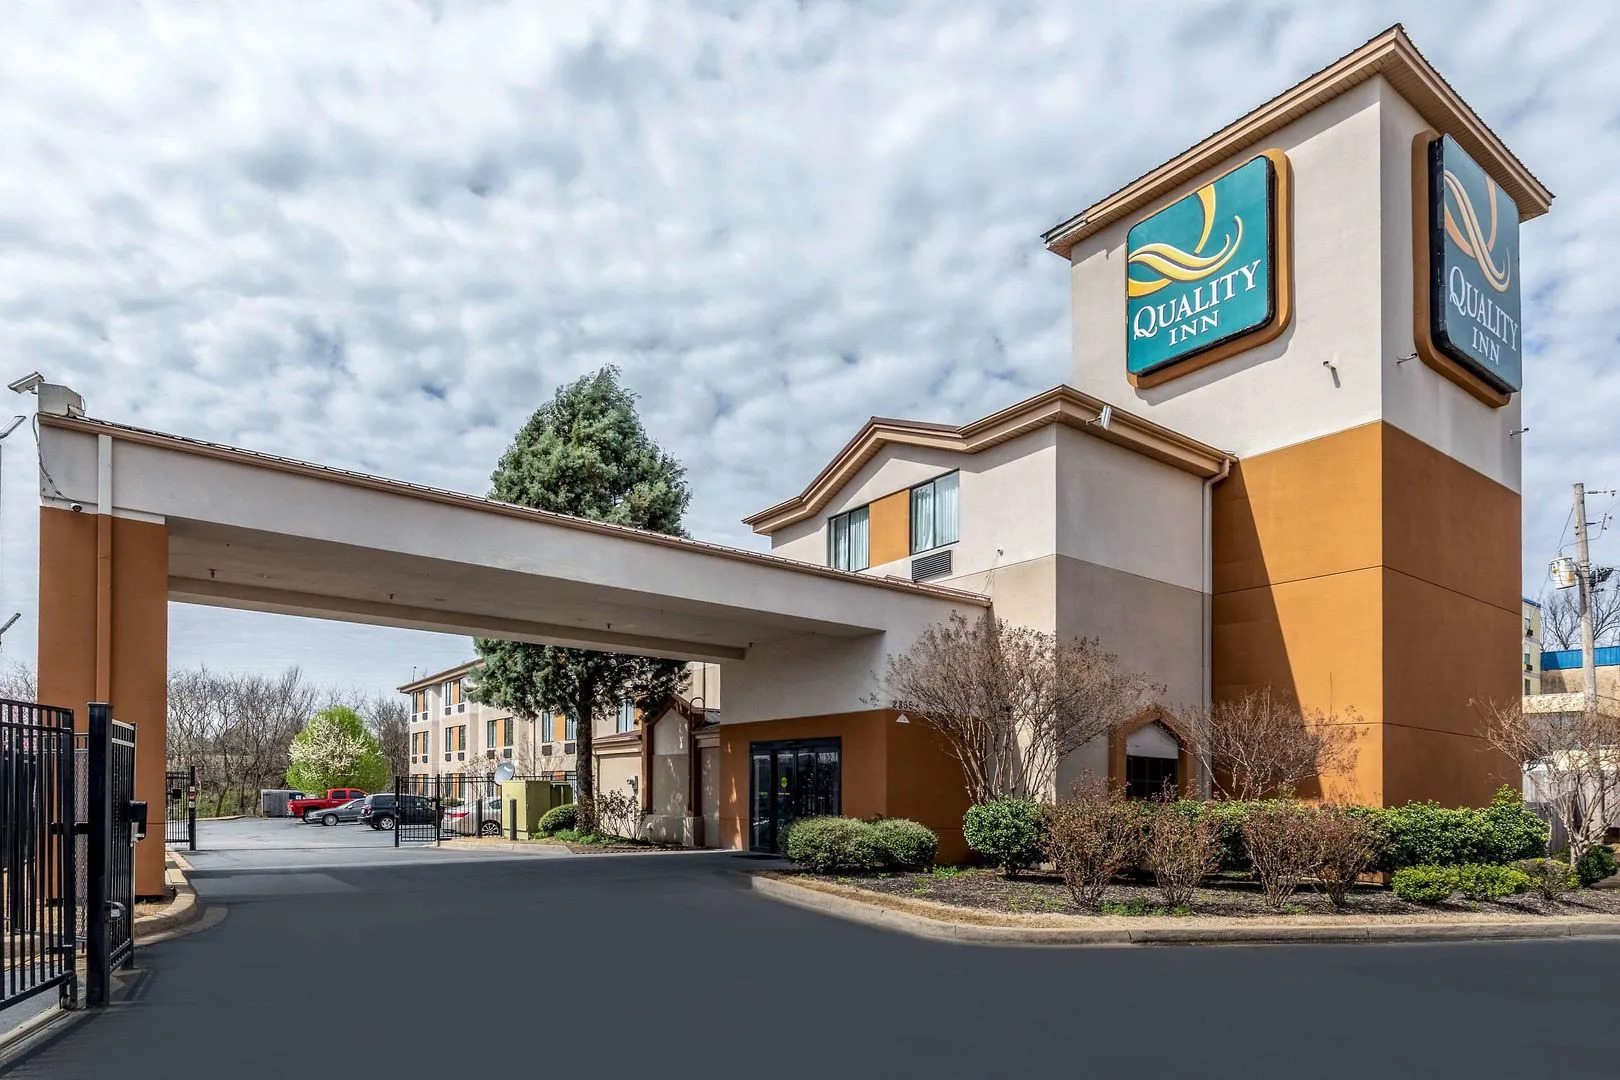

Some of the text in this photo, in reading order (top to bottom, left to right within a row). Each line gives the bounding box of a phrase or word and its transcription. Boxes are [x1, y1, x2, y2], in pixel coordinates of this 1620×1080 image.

[1133, 259, 1262, 341] QUALITY
[1168, 310, 1220, 346] INN
[1450, 266, 1518, 352] QUALITY
[1471, 326, 1501, 365] INN
